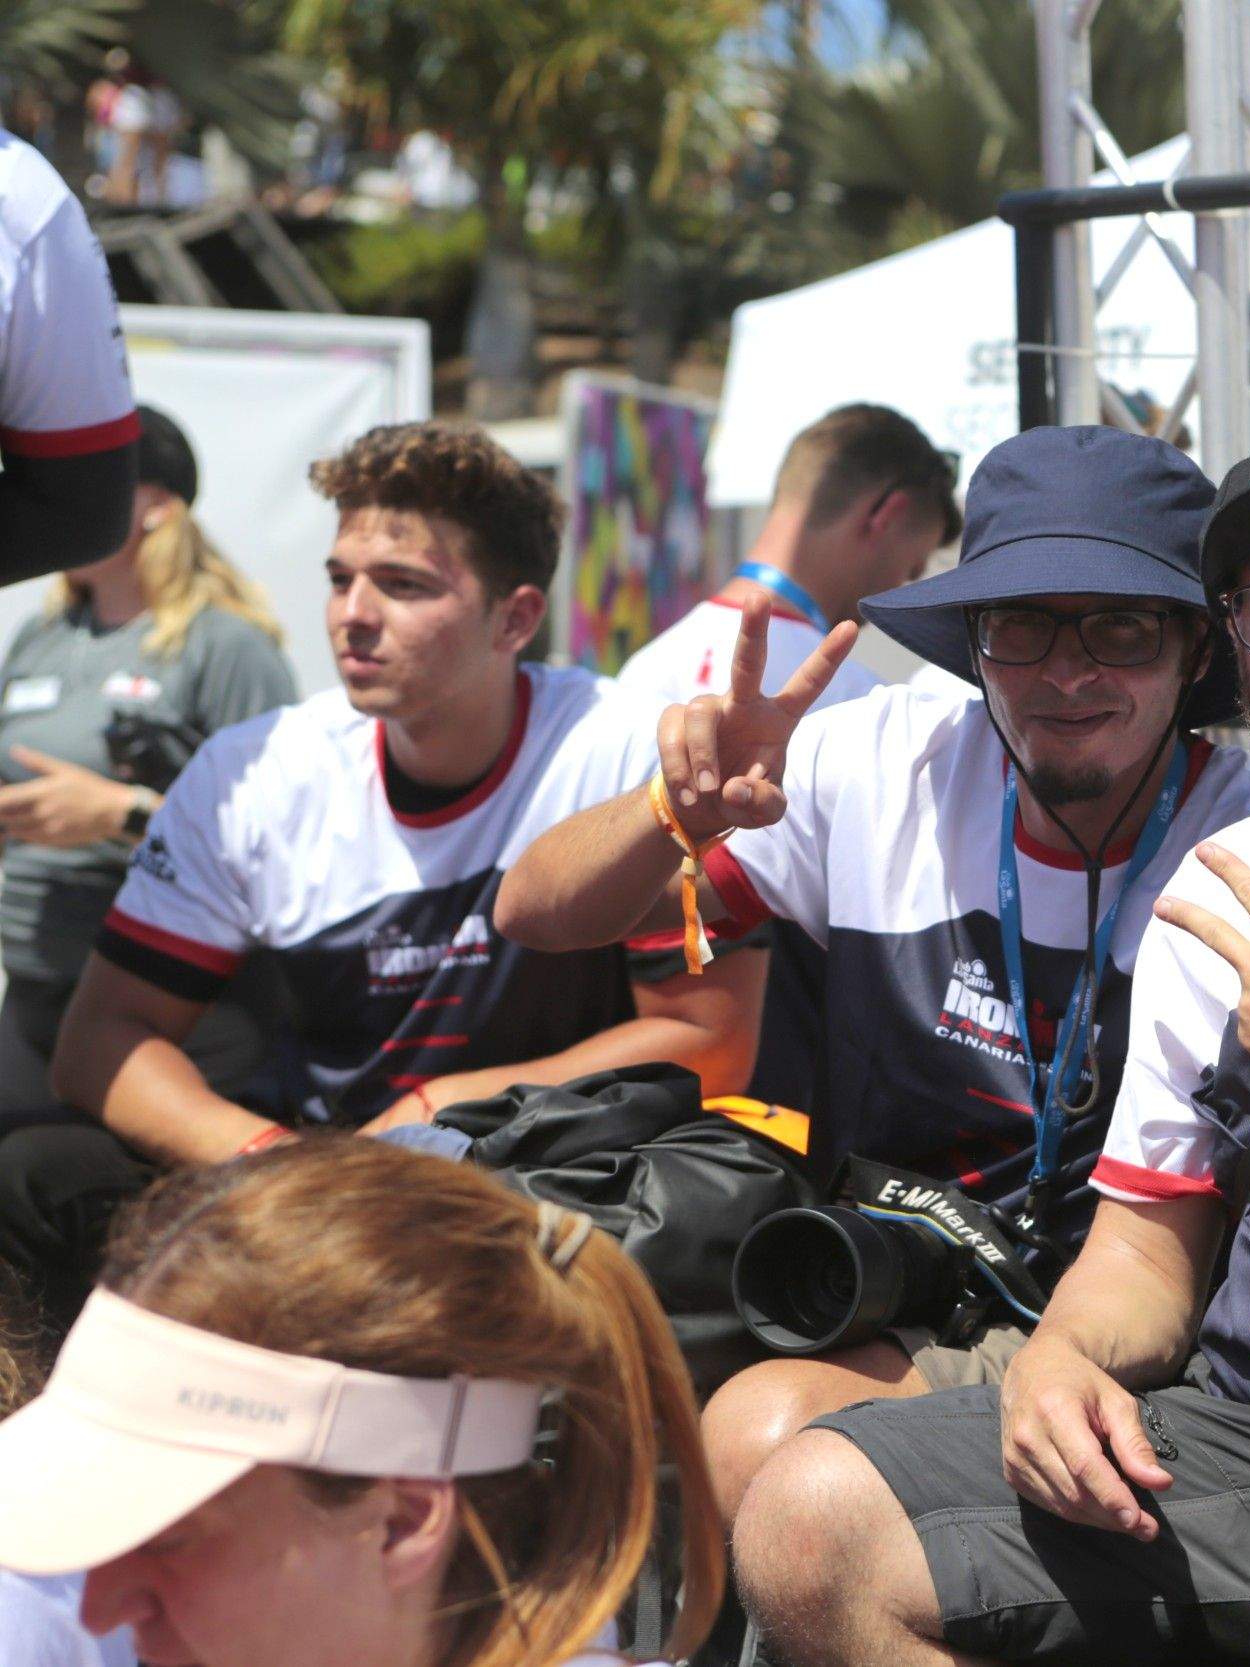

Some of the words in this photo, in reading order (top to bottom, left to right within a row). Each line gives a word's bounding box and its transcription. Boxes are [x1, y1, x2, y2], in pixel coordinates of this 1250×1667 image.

[934, 1026, 1033, 1066] CANARIA
[929, 1200, 986, 1247] Mark
[177, 1386, 289, 1425] KIPRUN
